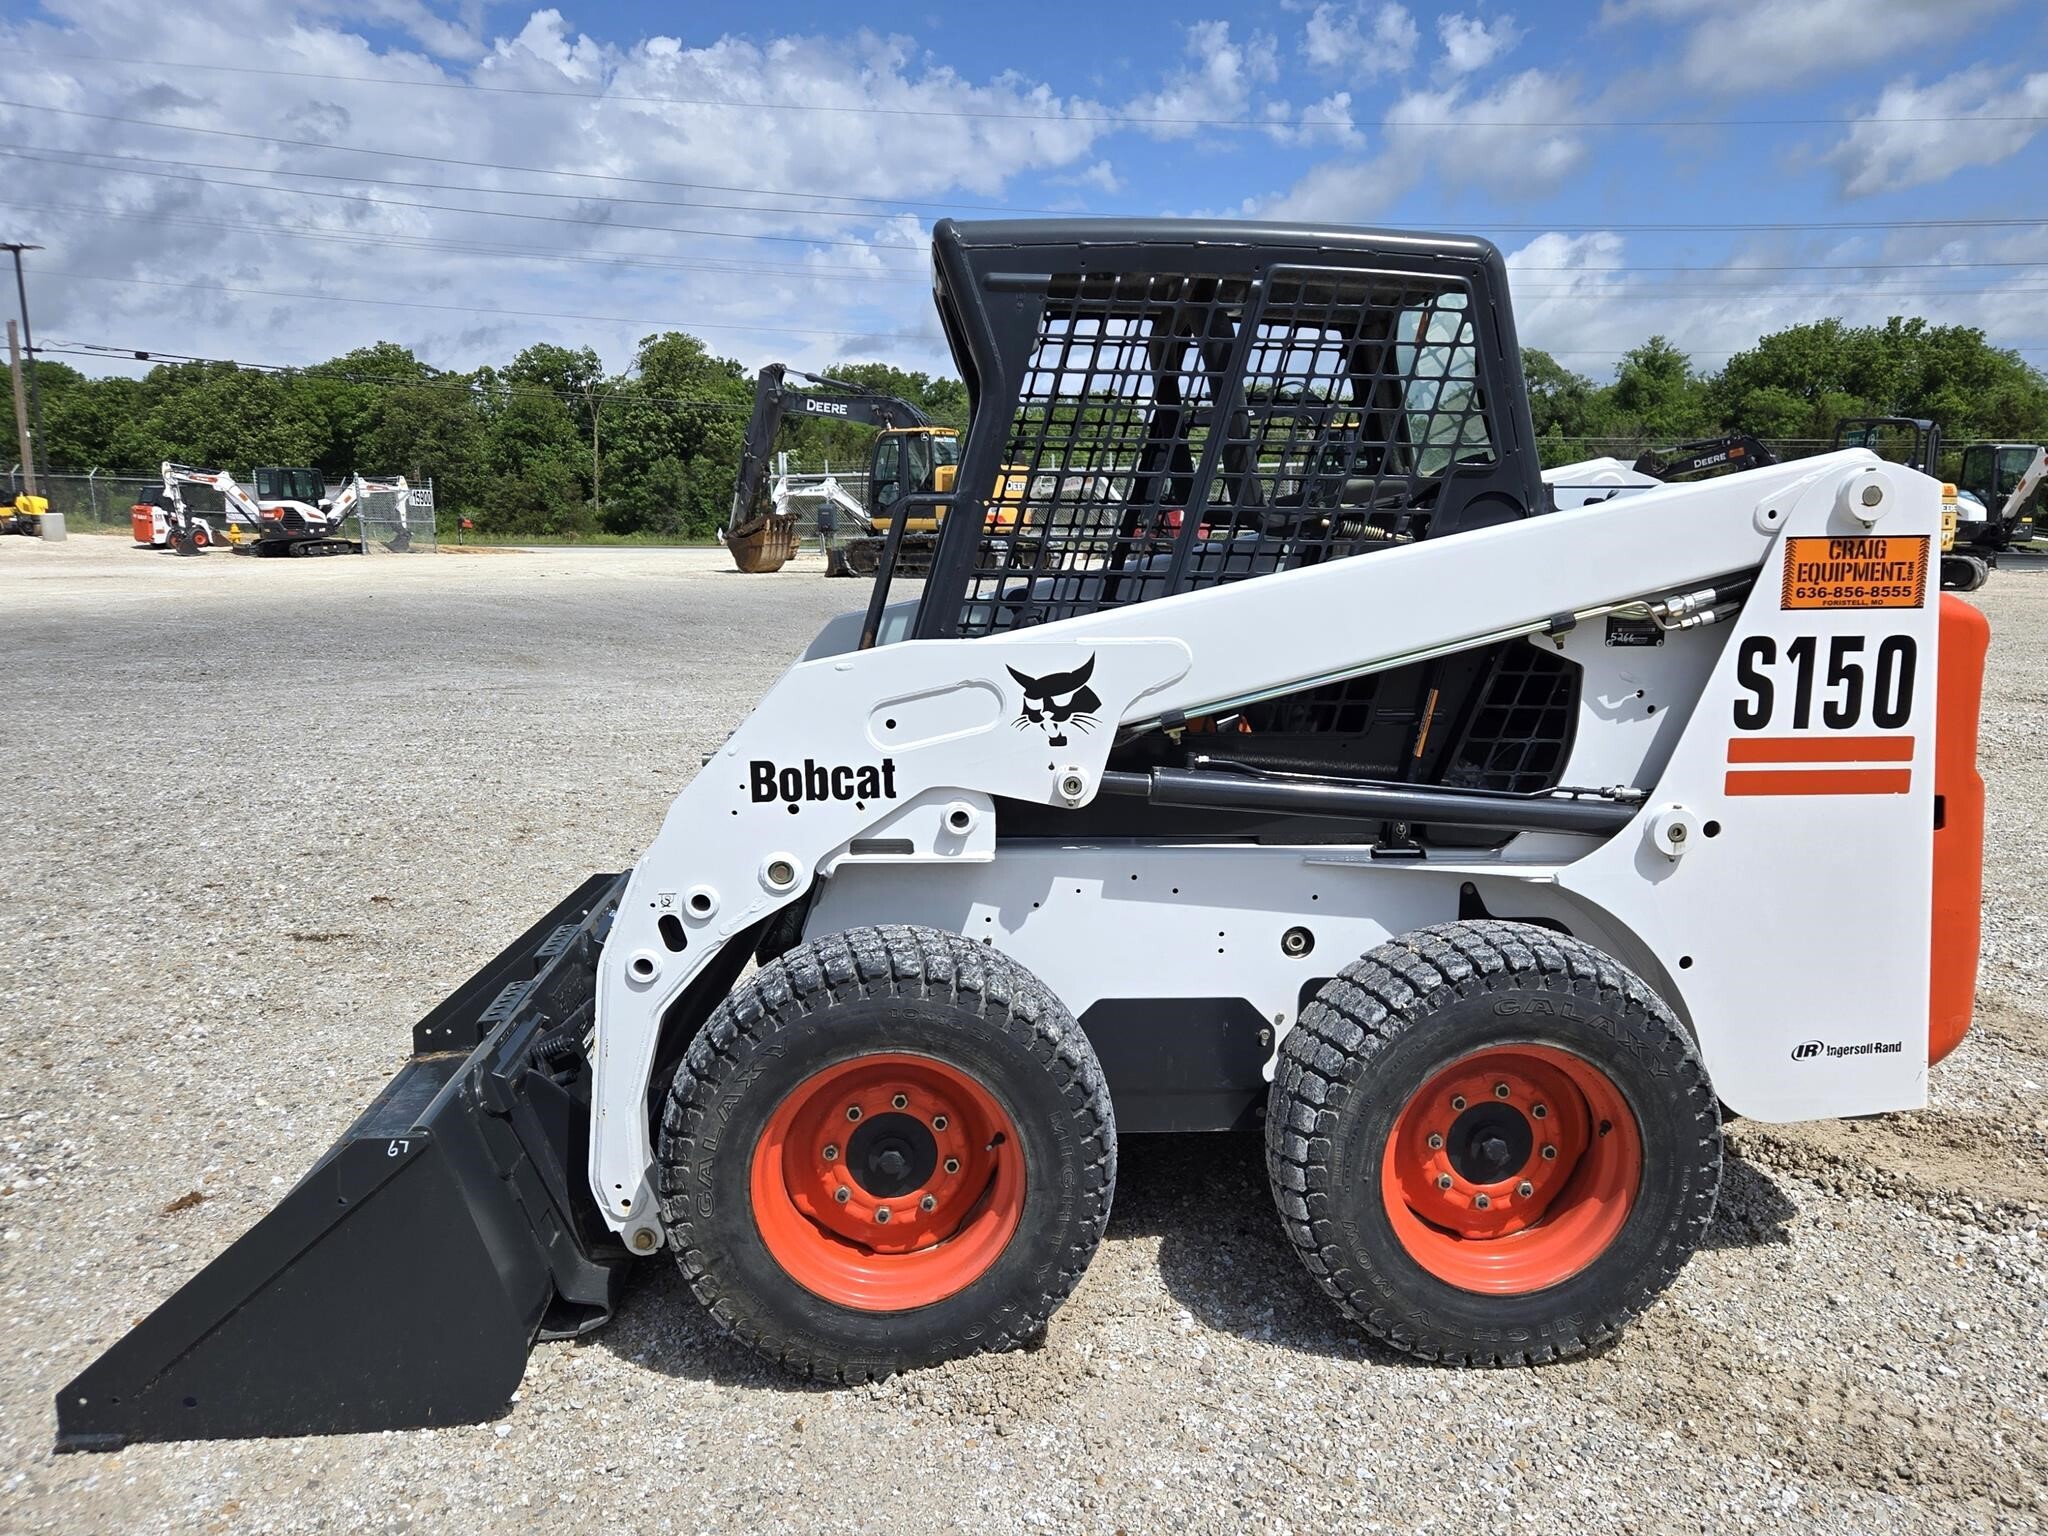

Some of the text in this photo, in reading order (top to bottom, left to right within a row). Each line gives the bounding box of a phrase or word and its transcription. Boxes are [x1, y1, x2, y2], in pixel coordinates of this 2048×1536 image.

[806, 398, 848, 415] DEERE
[1693, 452, 1727, 469] DEERE
[1829, 539, 1887, 560] CRAIG
[1796, 586, 1911, 599] 636-856-8555
[1733, 634, 1917, 731] S150
[750, 758, 896, 803] Bobcat
[1493, 998, 1671, 1079] GALAXY
[697, 1039, 788, 1218] GALAXY
[387, 1139, 410, 1157] 67
